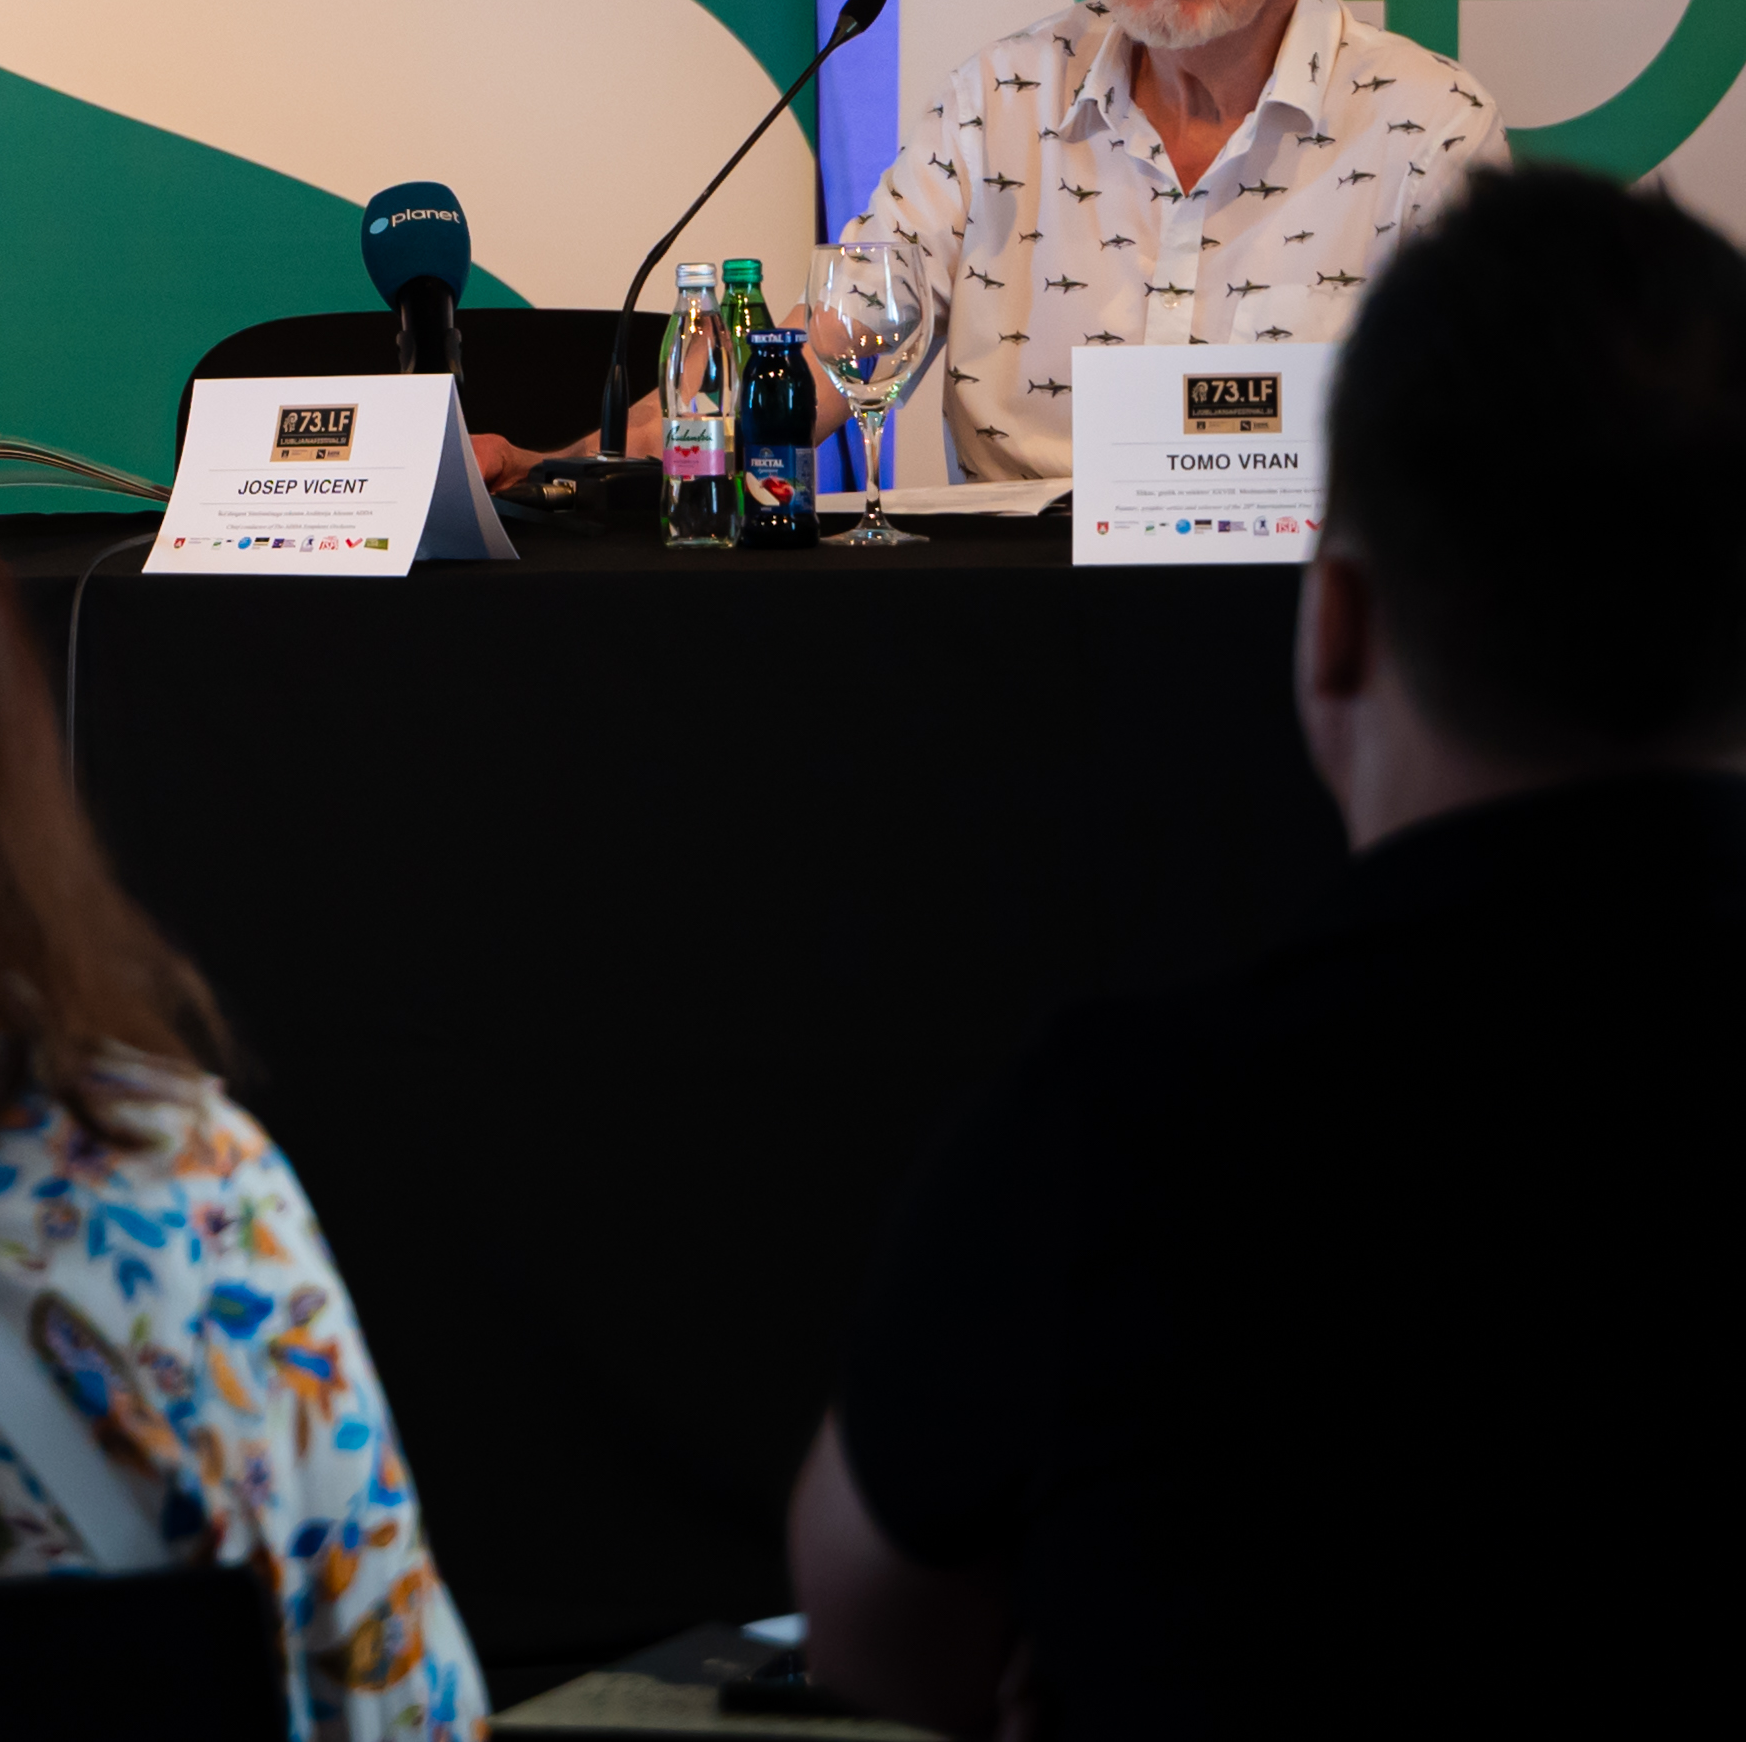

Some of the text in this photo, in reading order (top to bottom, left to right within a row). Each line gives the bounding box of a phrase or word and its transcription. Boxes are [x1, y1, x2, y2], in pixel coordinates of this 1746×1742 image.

[391, 208, 460, 227] planet
[1167, 453, 1298, 470] TOMO VRAN
[238, 479, 368, 495] JOSEP VICENT
